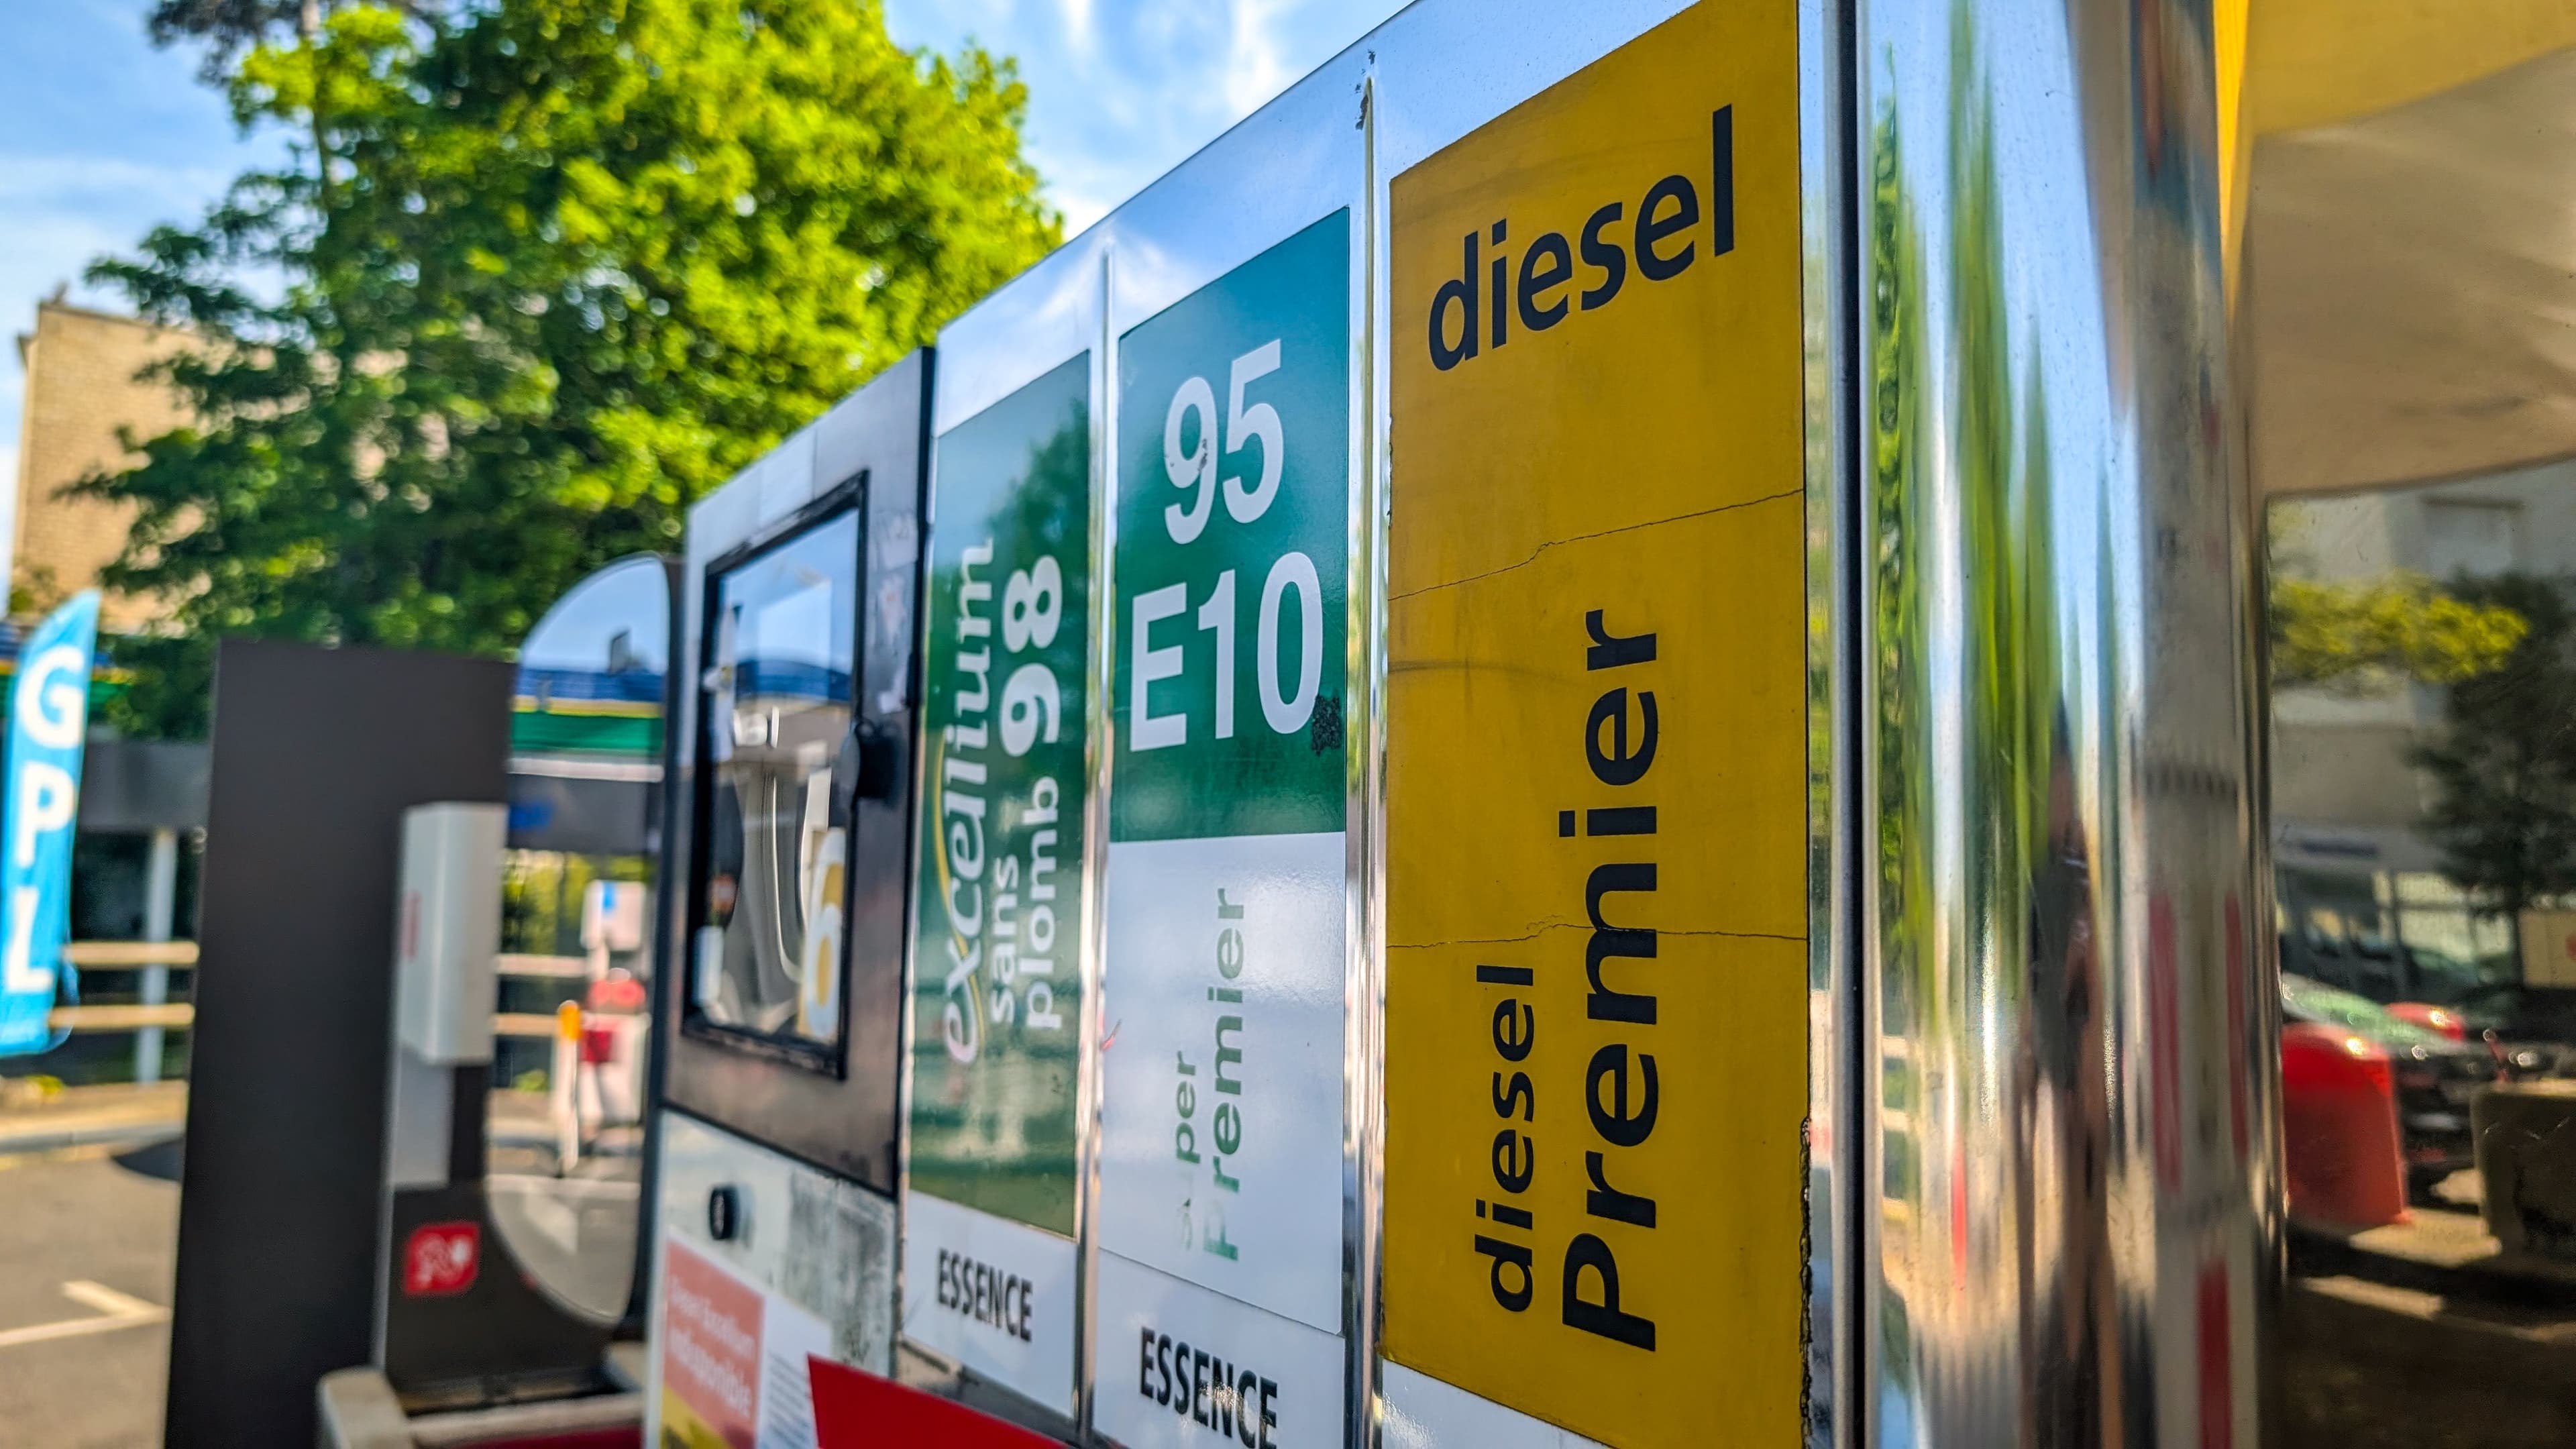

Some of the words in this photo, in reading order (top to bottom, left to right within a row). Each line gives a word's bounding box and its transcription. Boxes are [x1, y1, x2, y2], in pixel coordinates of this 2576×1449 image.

[1429, 103, 1734, 371] diesel
[1163, 338, 1284, 545] 95
[1000, 555, 1063, 757] 98
[1130, 551, 1324, 752] E10
[5, 644, 86, 994] GPL
[941, 536, 994, 1065] excellium
[1019, 775, 1062, 1029] plomb
[989, 854, 1020, 1024] sans
[1562, 608, 1660, 1352] Premier
[1203, 888, 1244, 1262] Premier
[1474, 964, 1534, 1313] diesel
[938, 1247, 1033, 1343] ESSENCE
[1140, 1326, 1278, 1449] ESSENCE
